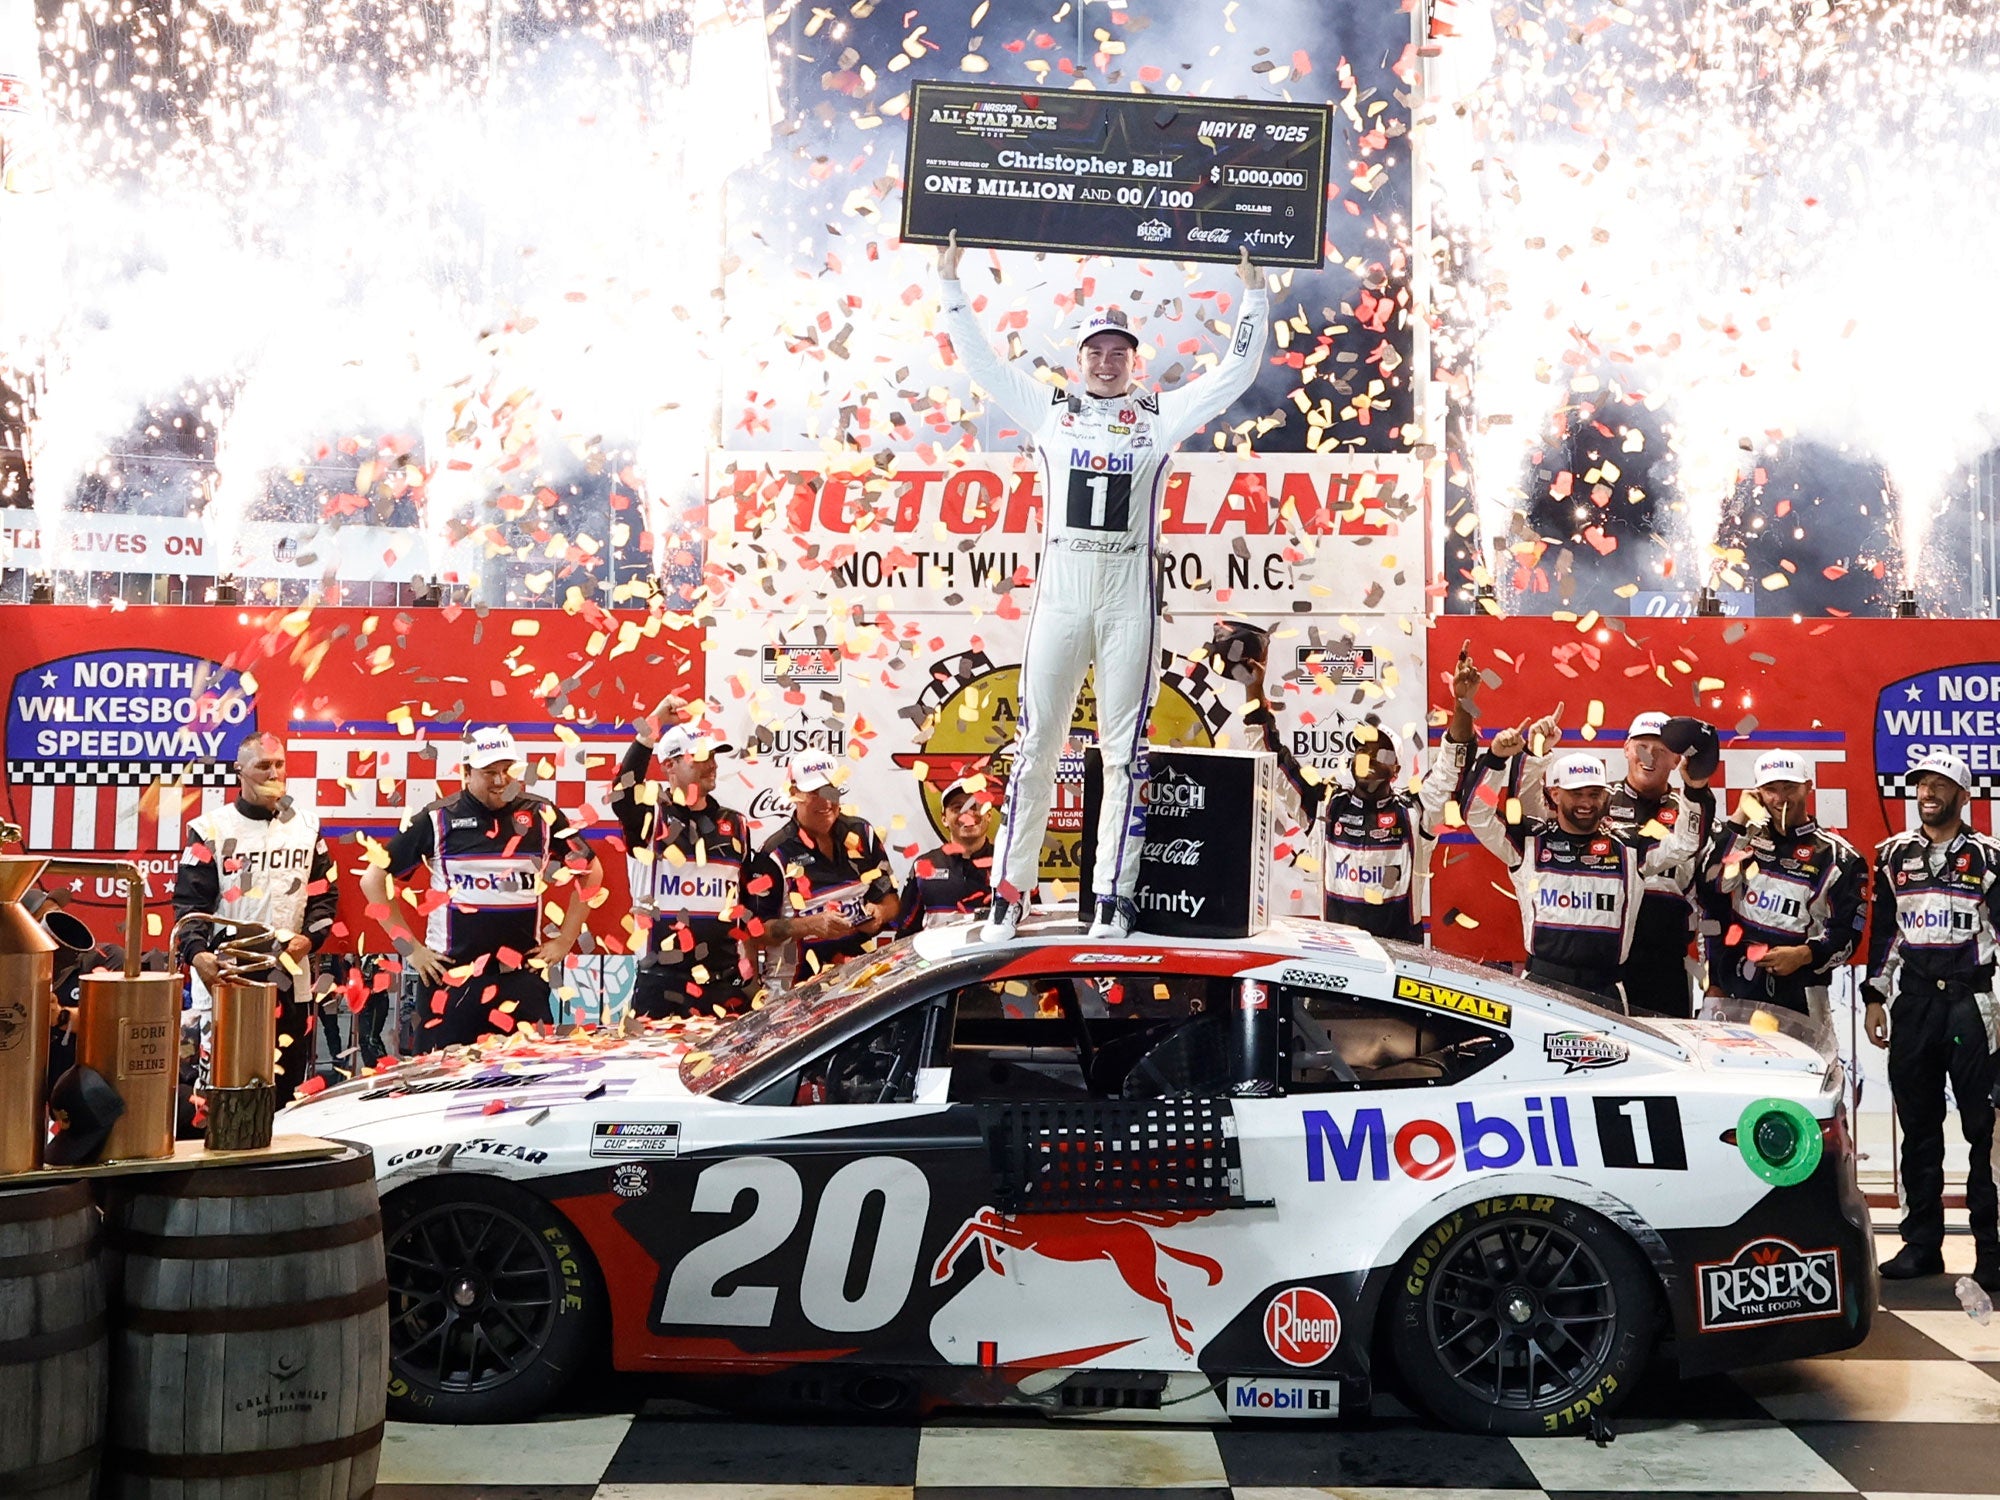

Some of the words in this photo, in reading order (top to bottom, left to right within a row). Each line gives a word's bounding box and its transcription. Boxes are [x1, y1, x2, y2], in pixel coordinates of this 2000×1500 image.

[983, 103, 1018, 113] NASCAR
[929, 110, 962, 124] ALL
[966, 112, 1008, 127] STAR
[1011, 115, 1058, 130] RACE
[1197, 120, 1238, 138] MAY
[998, 149, 1127, 176] Christopher
[1131, 159, 1173, 178] Bell
[1210, 165, 1220, 183] $
[1228, 168, 1304, 187] 1,000,000
[924, 175, 972, 194] ONE
[977, 178, 1075, 201] MILLION
[1080, 188, 1112, 200] AND
[1235, 204, 1272, 213] DOLLARS
[1137, 223, 1172, 239] BUSCH
[1243, 229, 1295, 248] xfinity
[1070, 448, 1133, 472] Mobil
[734, 470, 1043, 534] VICTOR
[1161, 472, 1399, 535] LANE
[1086, 476, 1109, 526] 1
[72, 529, 147, 554] LIVES
[164, 535, 203, 557] ON
[73, 662, 194, 689] NORTH
[17, 696, 247, 724] WILKESBORO
[36, 730, 226, 757] SPEEDWAY
[477, 740, 501, 752] Mobil
[803, 762, 827, 774] Mobil
[1569, 765, 1594, 775] Mobil
[1760, 761, 1784, 771] Mobil
[1148, 783, 1205, 809] USCH
[1259, 762, 1270, 843] SERIES
[1147, 805, 1188, 818] LIGHT
[1058, 819, 1080, 827] USA
[1142, 838, 1205, 866] ca-Cola
[1257, 846, 1267, 893] CUP
[1335, 862, 1382, 884] Mobil
[95, 877, 154, 898] USA
[660, 873, 722, 897] Mobil
[1540, 887, 1592, 910] Mobil
[1742, 886, 1781, 914] obil
[1902, 908, 1948, 929] Mobil
[131, 1026, 166, 1040] BORN
[1550, 1037, 1625, 1051] INTERSTATE
[141, 1044, 157, 1055] TO
[1555, 1048, 1624, 1058] BATTERIES
[128, 1058, 166, 1071] SHINE
[620, 1125, 668, 1135] NASCAR
[1303, 1096, 1579, 1182] Mobil
[604, 1139, 627, 1149] CUP
[615, 1165, 647, 1178] NASCAR
[613, 1185, 648, 1197] SALUTES
[660, 1156, 931, 1333] 20
[542, 1226, 582, 1311] EAGLE
[1709, 1254, 1832, 1322] RESER'S
[1741, 1303, 1766, 1315] FINE
[1768, 1299, 1802, 1312] FOODS
[1274, 1291, 1336, 1352] Rheem
[1236, 1386, 1303, 1409] Mobil
[1543, 1373, 1618, 1433] EAGLE
